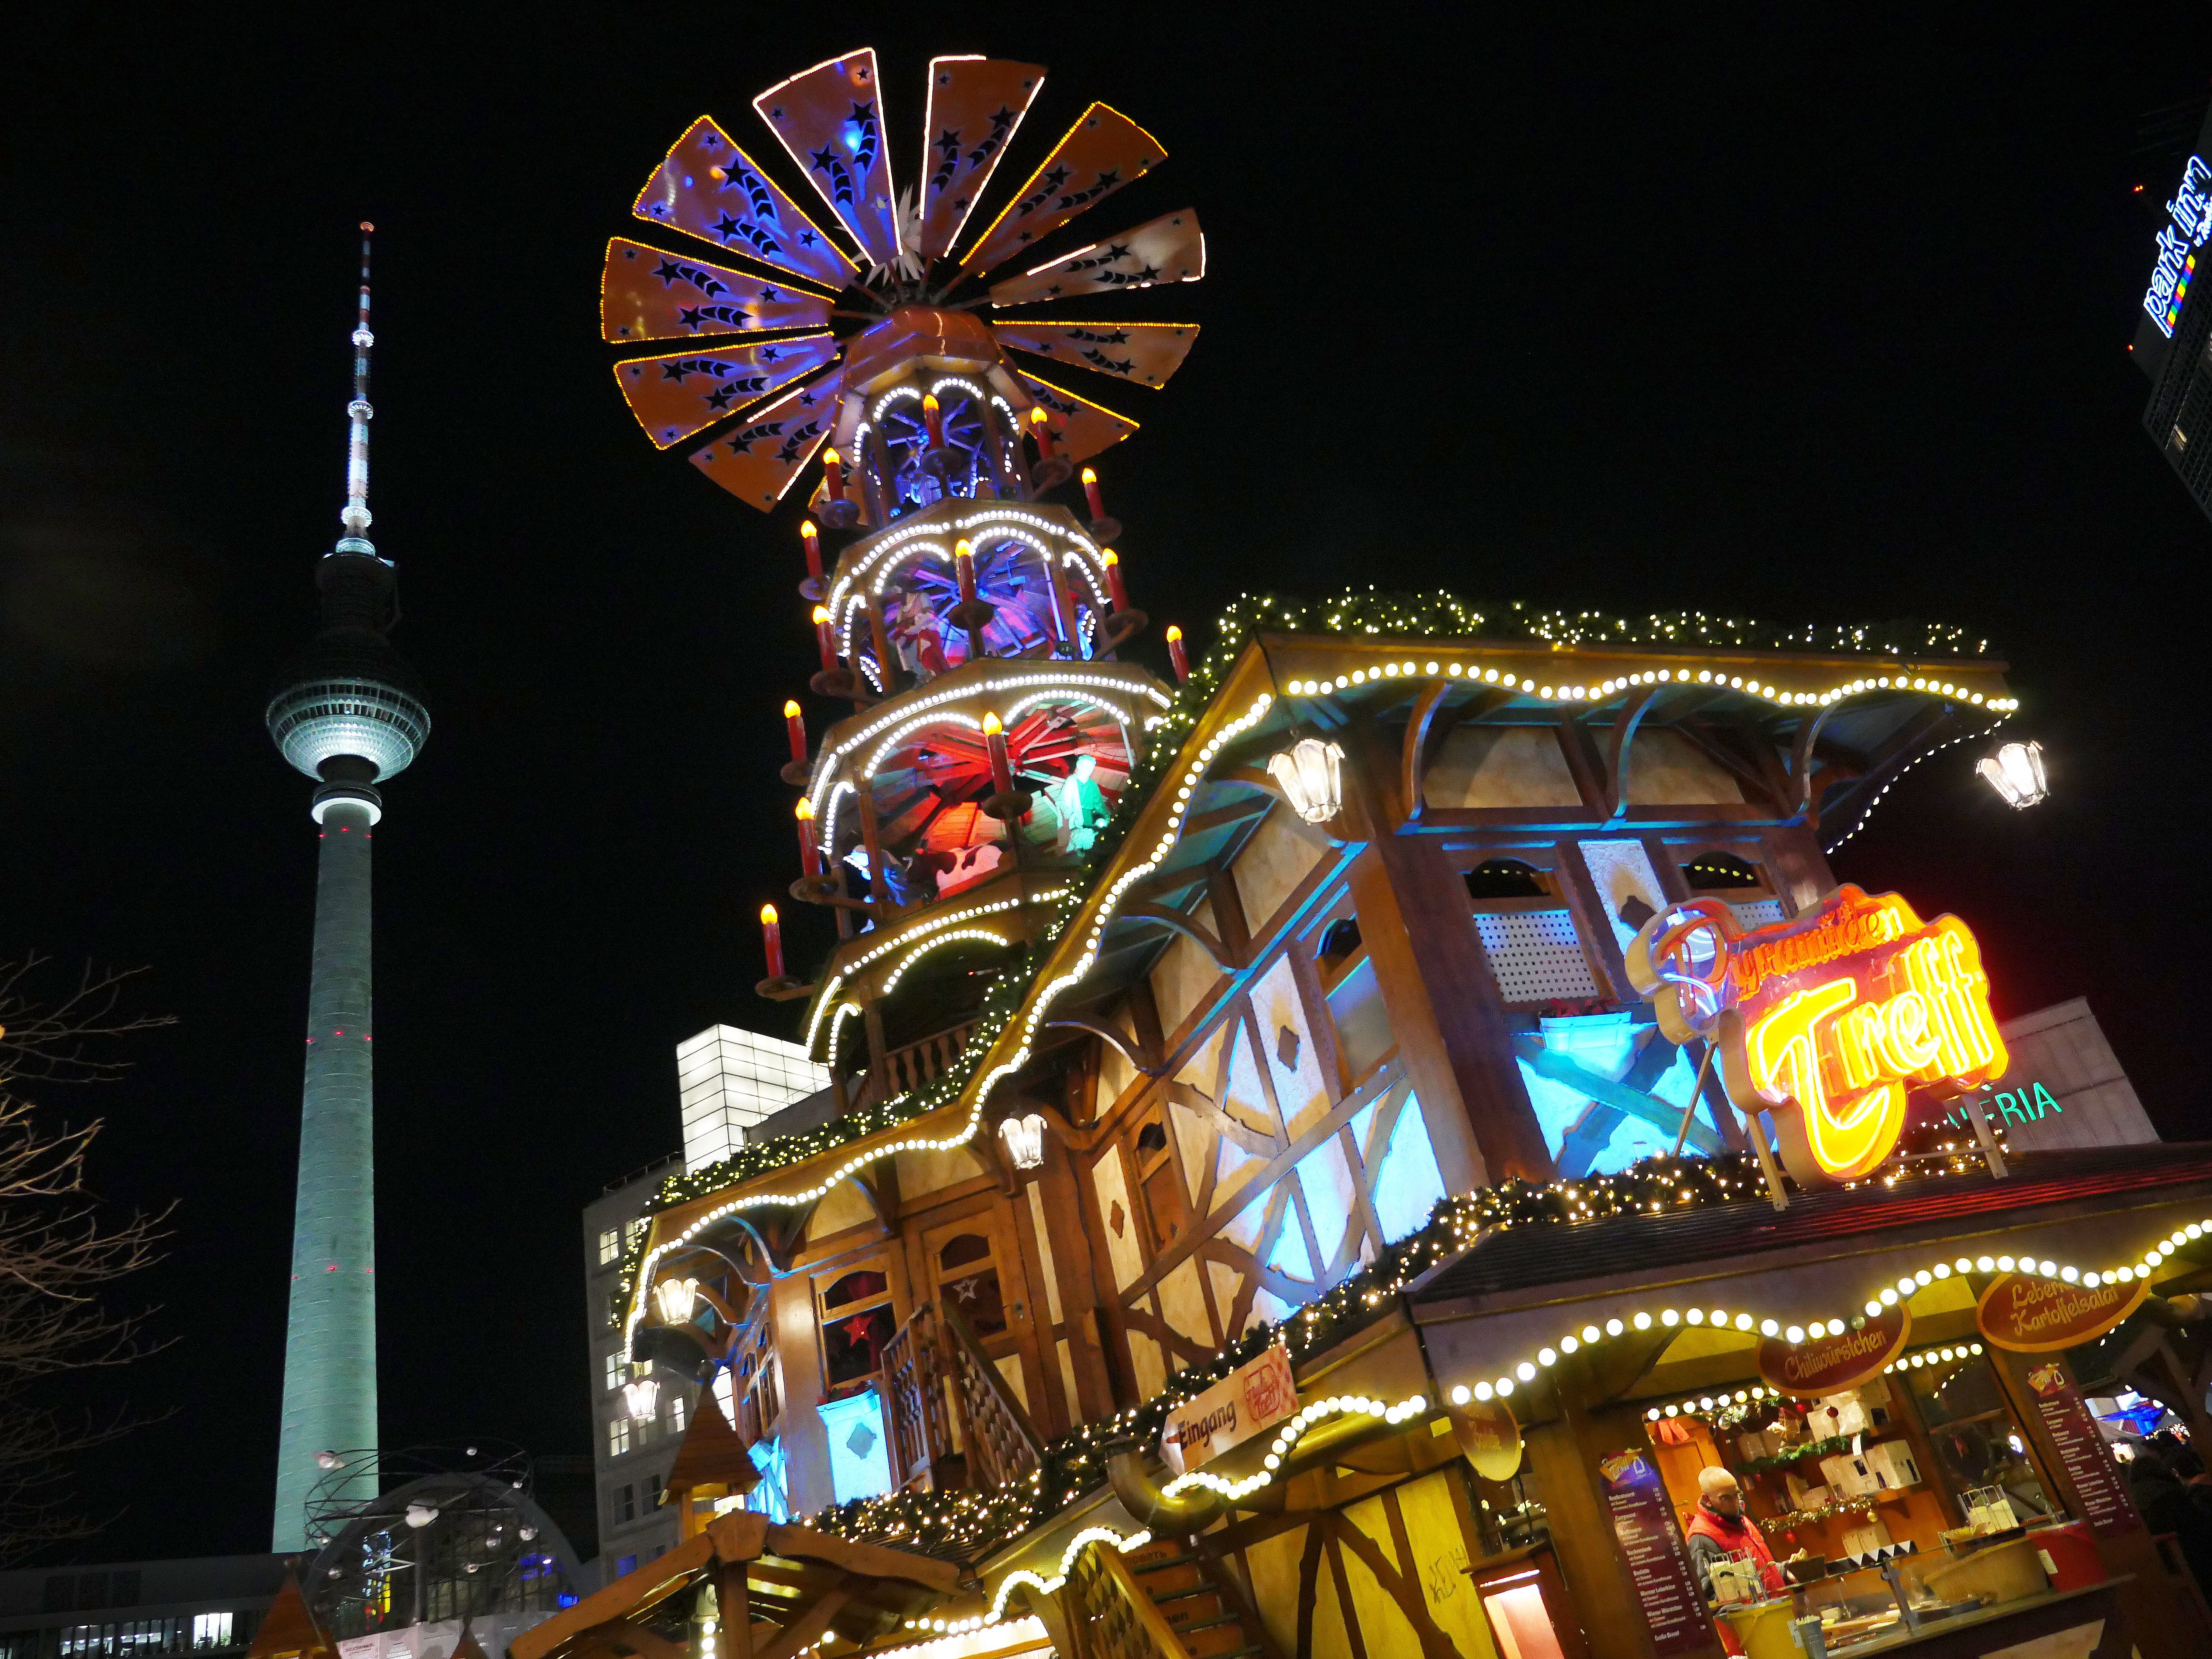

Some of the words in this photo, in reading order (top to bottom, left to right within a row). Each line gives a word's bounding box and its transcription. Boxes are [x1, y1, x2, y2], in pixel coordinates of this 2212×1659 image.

[2165, 155, 2212, 237] inn
[2143, 224, 2189, 338] park
[1653, 899, 1906, 1017] Pyramiden
[1747, 928, 1996, 1169] Treff
[2010, 1286, 2120, 1337] Kartoffelsalat
[1177, 1400, 1237, 1449] Eingang
